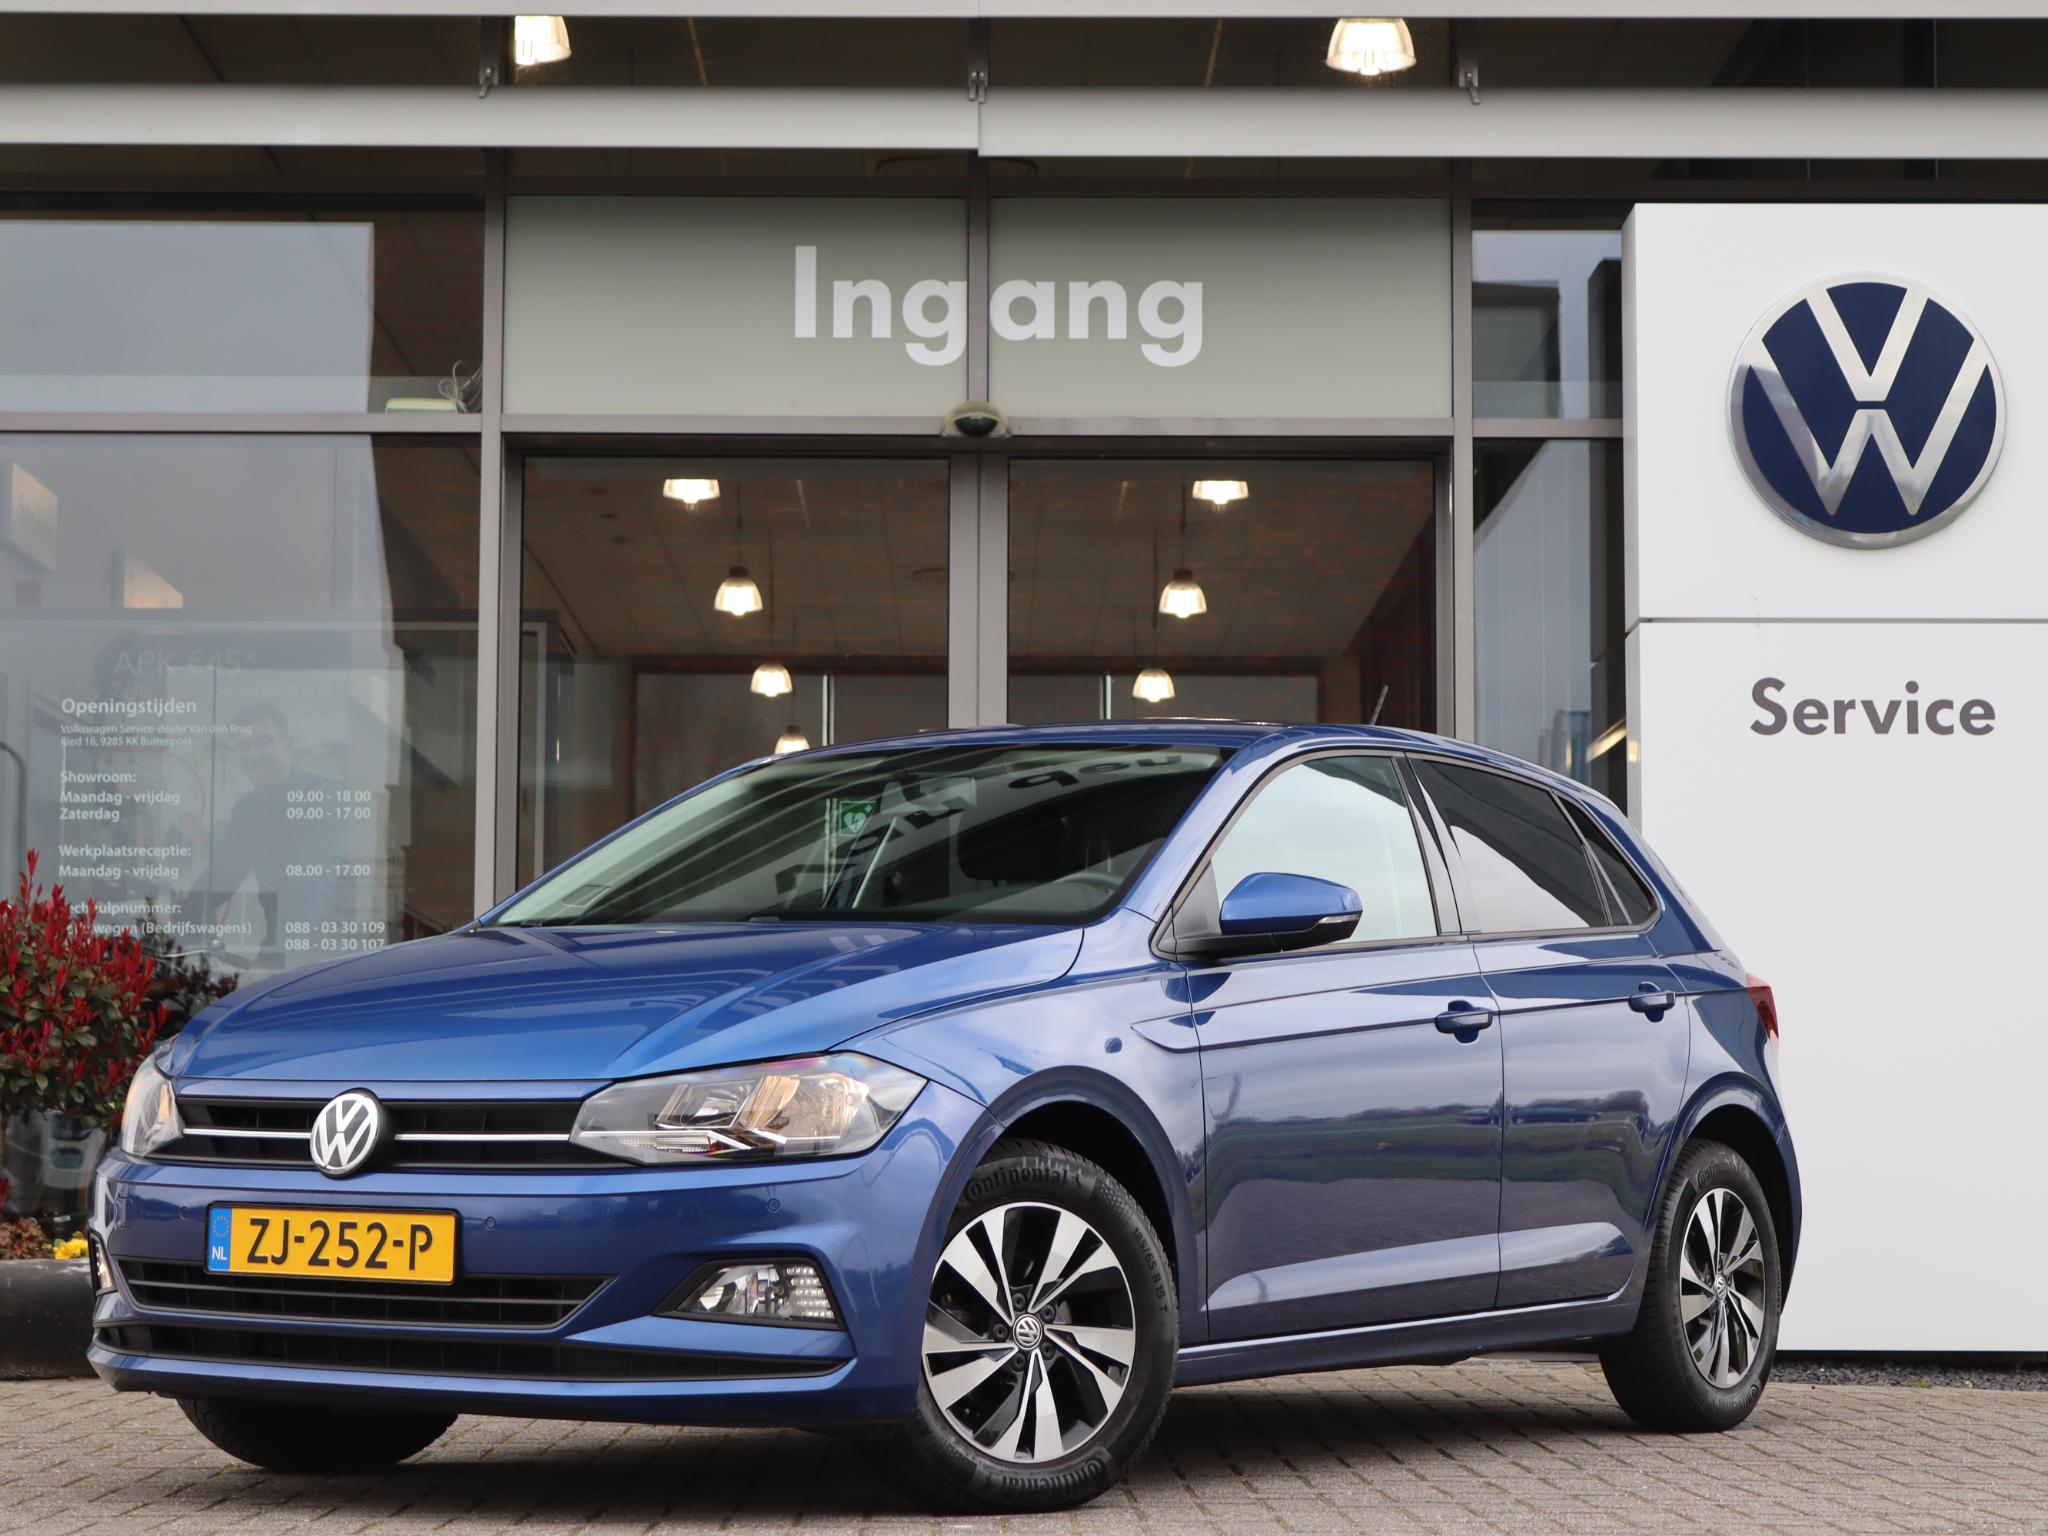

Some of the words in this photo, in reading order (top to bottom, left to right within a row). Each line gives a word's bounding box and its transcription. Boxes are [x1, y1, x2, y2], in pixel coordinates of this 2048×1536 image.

[795, 245, 1203, 367] Ingang
[113, 649, 176, 676] APK
[62, 698, 197, 718] Openingstijden
[1750, 677, 1996, 736] Service
[61, 724, 118, 736] Volkswagen
[189, 724, 207, 734] Van
[230, 724, 253, 736] Brug
[85, 736, 98, 748] 16,
[101, 736, 124, 746] 9285
[126, 736, 138, 746] KK
[60, 770, 136, 783] Showroom:
[60, 789, 122, 806] Maandag
[133, 789, 181, 806] vrijdag
[286, 789, 324, 802] 09.00
[59, 807, 121, 823] Zaterdag
[285, 807, 324, 819] 09.00
[58, 844, 192, 860] Werkplaatsreceptie:
[58, 864, 121, 880] Maandag
[132, 864, 180, 880] vrijdag
[285, 864, 323, 877] 08.00
[333, 864, 371, 877] 17.00
[141, 921, 253, 937] (Bedrijfswagens)
[284, 921, 311, 934] 088
[321, 921, 338, 934] 03
[340, 921, 357, 934] 30
[361, 921, 386, 934] 109
[284, 938, 311, 951] 088
[321, 938, 338, 951] 03
[340, 938, 357, 951] 30
[361, 938, 385, 951] 107
[964, 1166, 1068, 1204] Continental
[211, 1245, 228, 1262] NL
[247, 1217, 433, 1271] ZJ-252-P
[1132, 1228, 1157, 1271] 185/65
[1152, 1274, 1161, 1285] R
